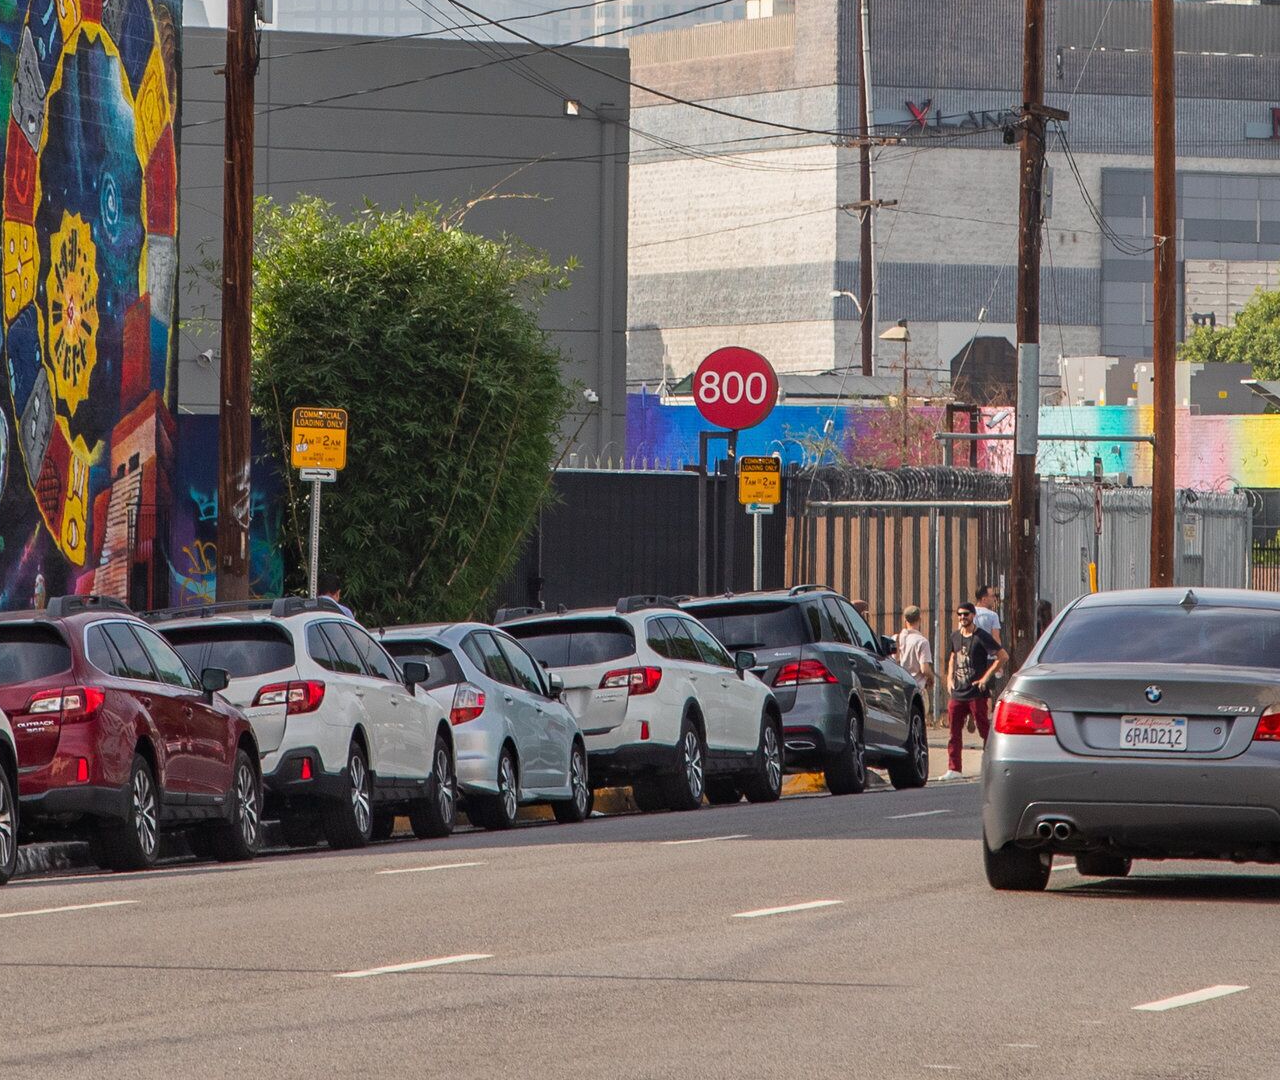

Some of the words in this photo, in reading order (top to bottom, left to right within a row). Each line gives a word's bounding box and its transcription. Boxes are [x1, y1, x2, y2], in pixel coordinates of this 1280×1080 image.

[698, 370, 768, 405] 800
[300, 410, 342, 420] COMMRCIAL
[296, 419, 324, 427] LOADING
[326, 420, 344, 428] ONLY
[1125, 728, 1183, 745] 6RAD212
